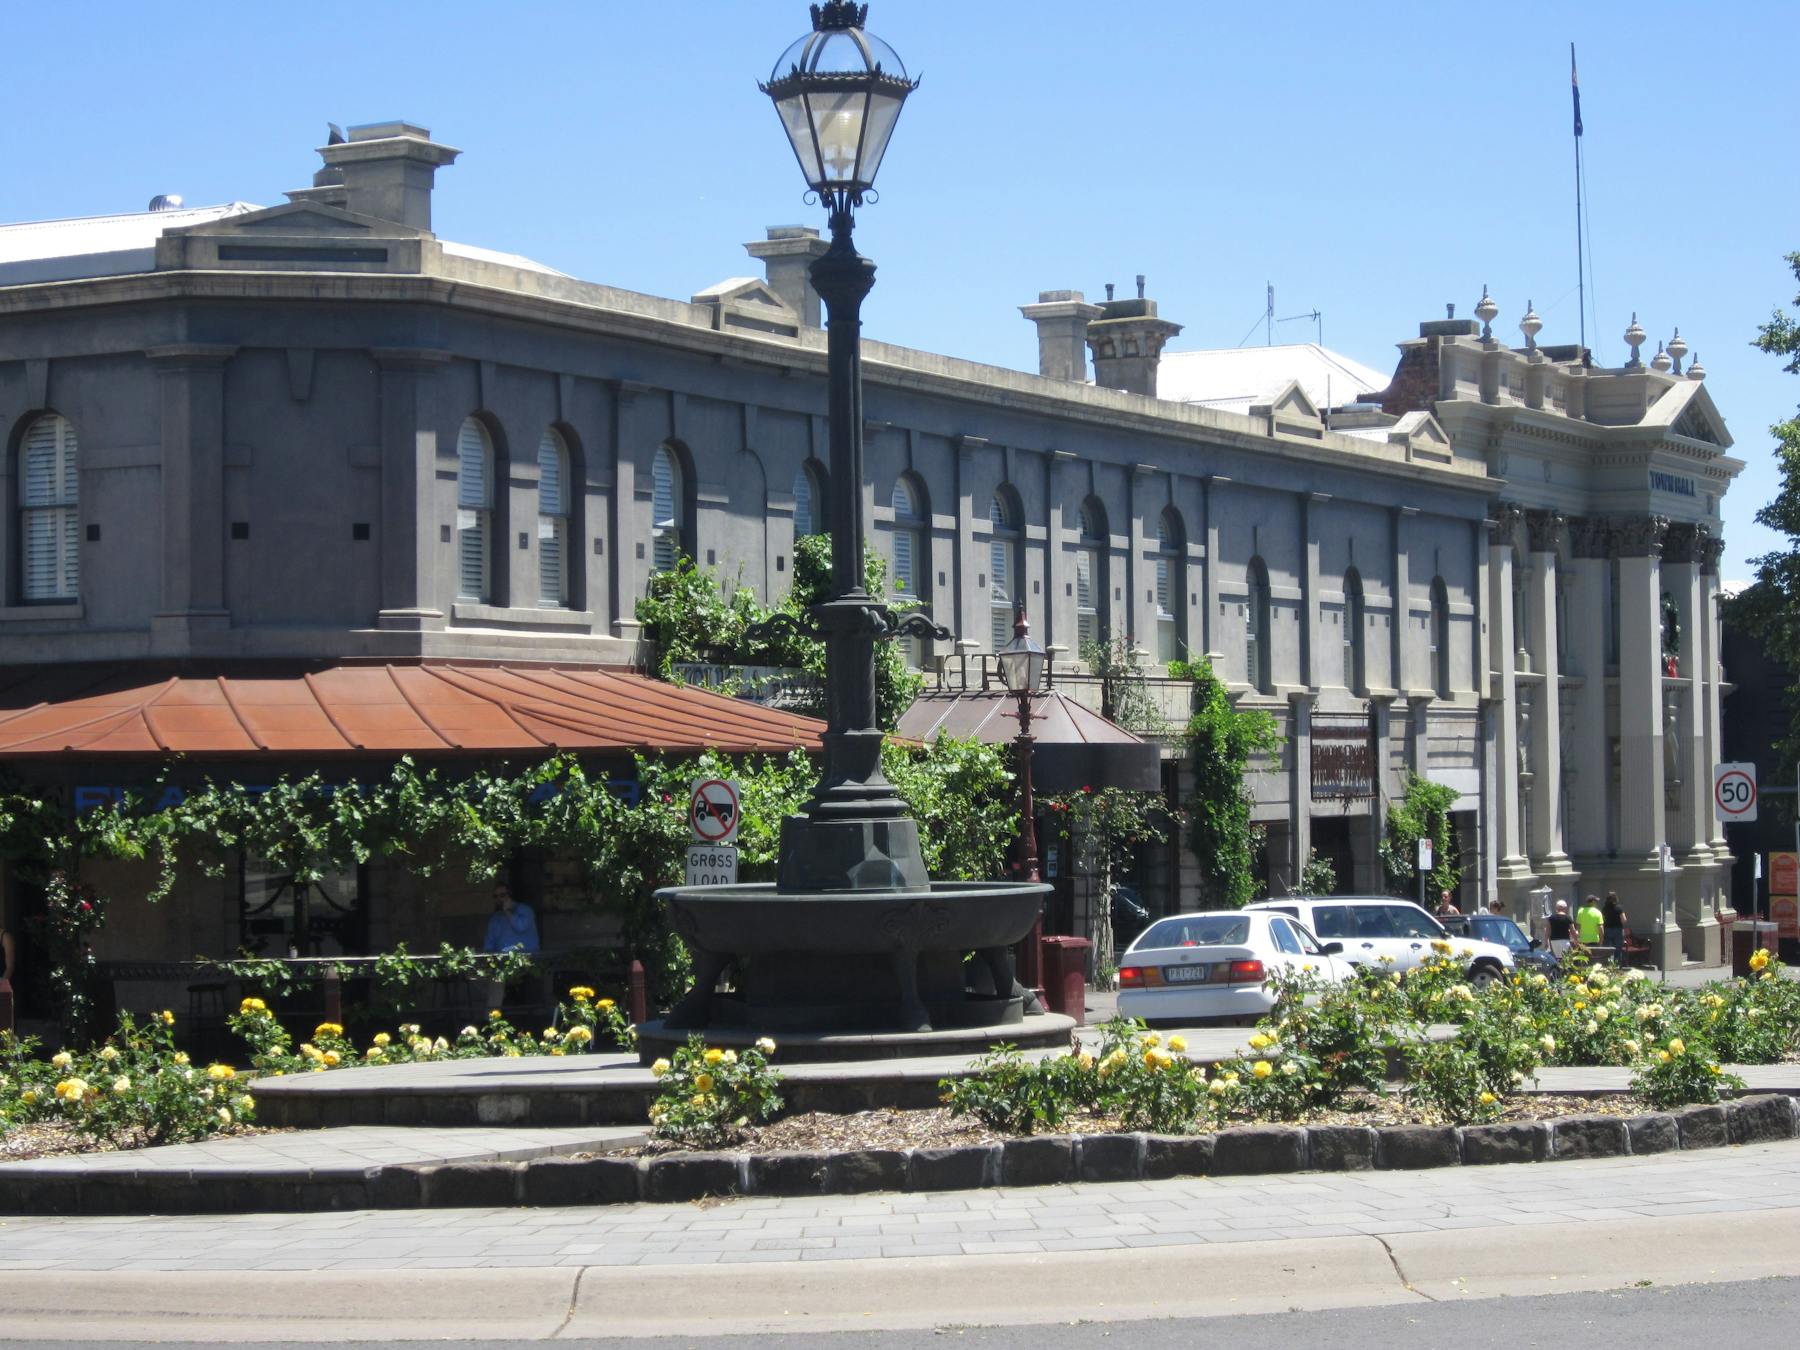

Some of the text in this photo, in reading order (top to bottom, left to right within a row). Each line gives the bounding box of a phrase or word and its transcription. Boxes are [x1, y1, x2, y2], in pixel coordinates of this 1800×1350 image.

[1649, 470, 1674, 492] TOWN
[1722, 782, 1749, 803] 50
[690, 853, 733, 868] GROSS
